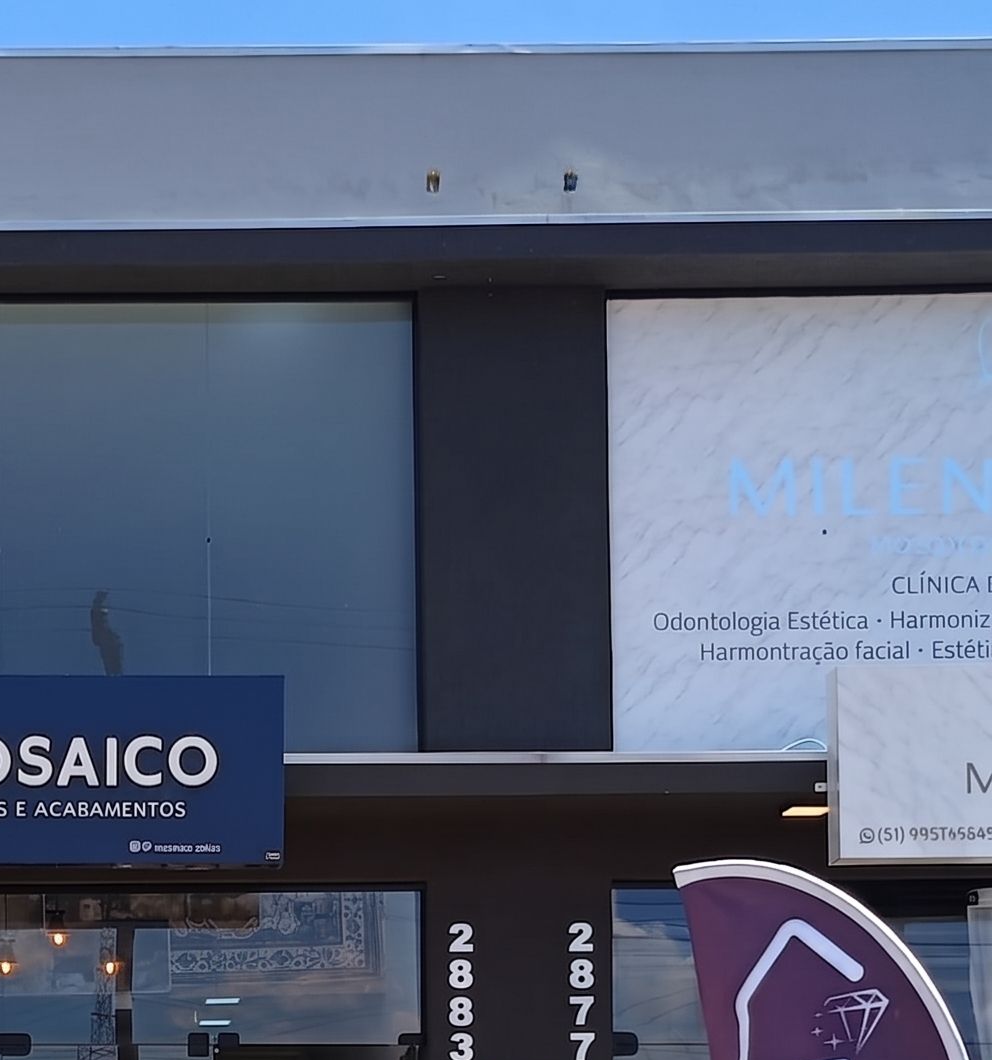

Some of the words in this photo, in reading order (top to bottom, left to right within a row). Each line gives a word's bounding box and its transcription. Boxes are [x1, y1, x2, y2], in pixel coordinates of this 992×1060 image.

[729, 455, 992, 517] MILEN
[892, 571, 980, 594] CLÍNICA
[653, 611, 781, 637] Odontologia
[788, 610, 869, 630] Estética
[890, 609, 991, 629] Harmoniz
[856, 640, 910, 660] facial
[932, 638, 992, 659] Estéti
[16, 801, 27, 817] E
[33, 801, 186, 818] ACABAMENTOS
[877, 826, 905, 845] (51)
